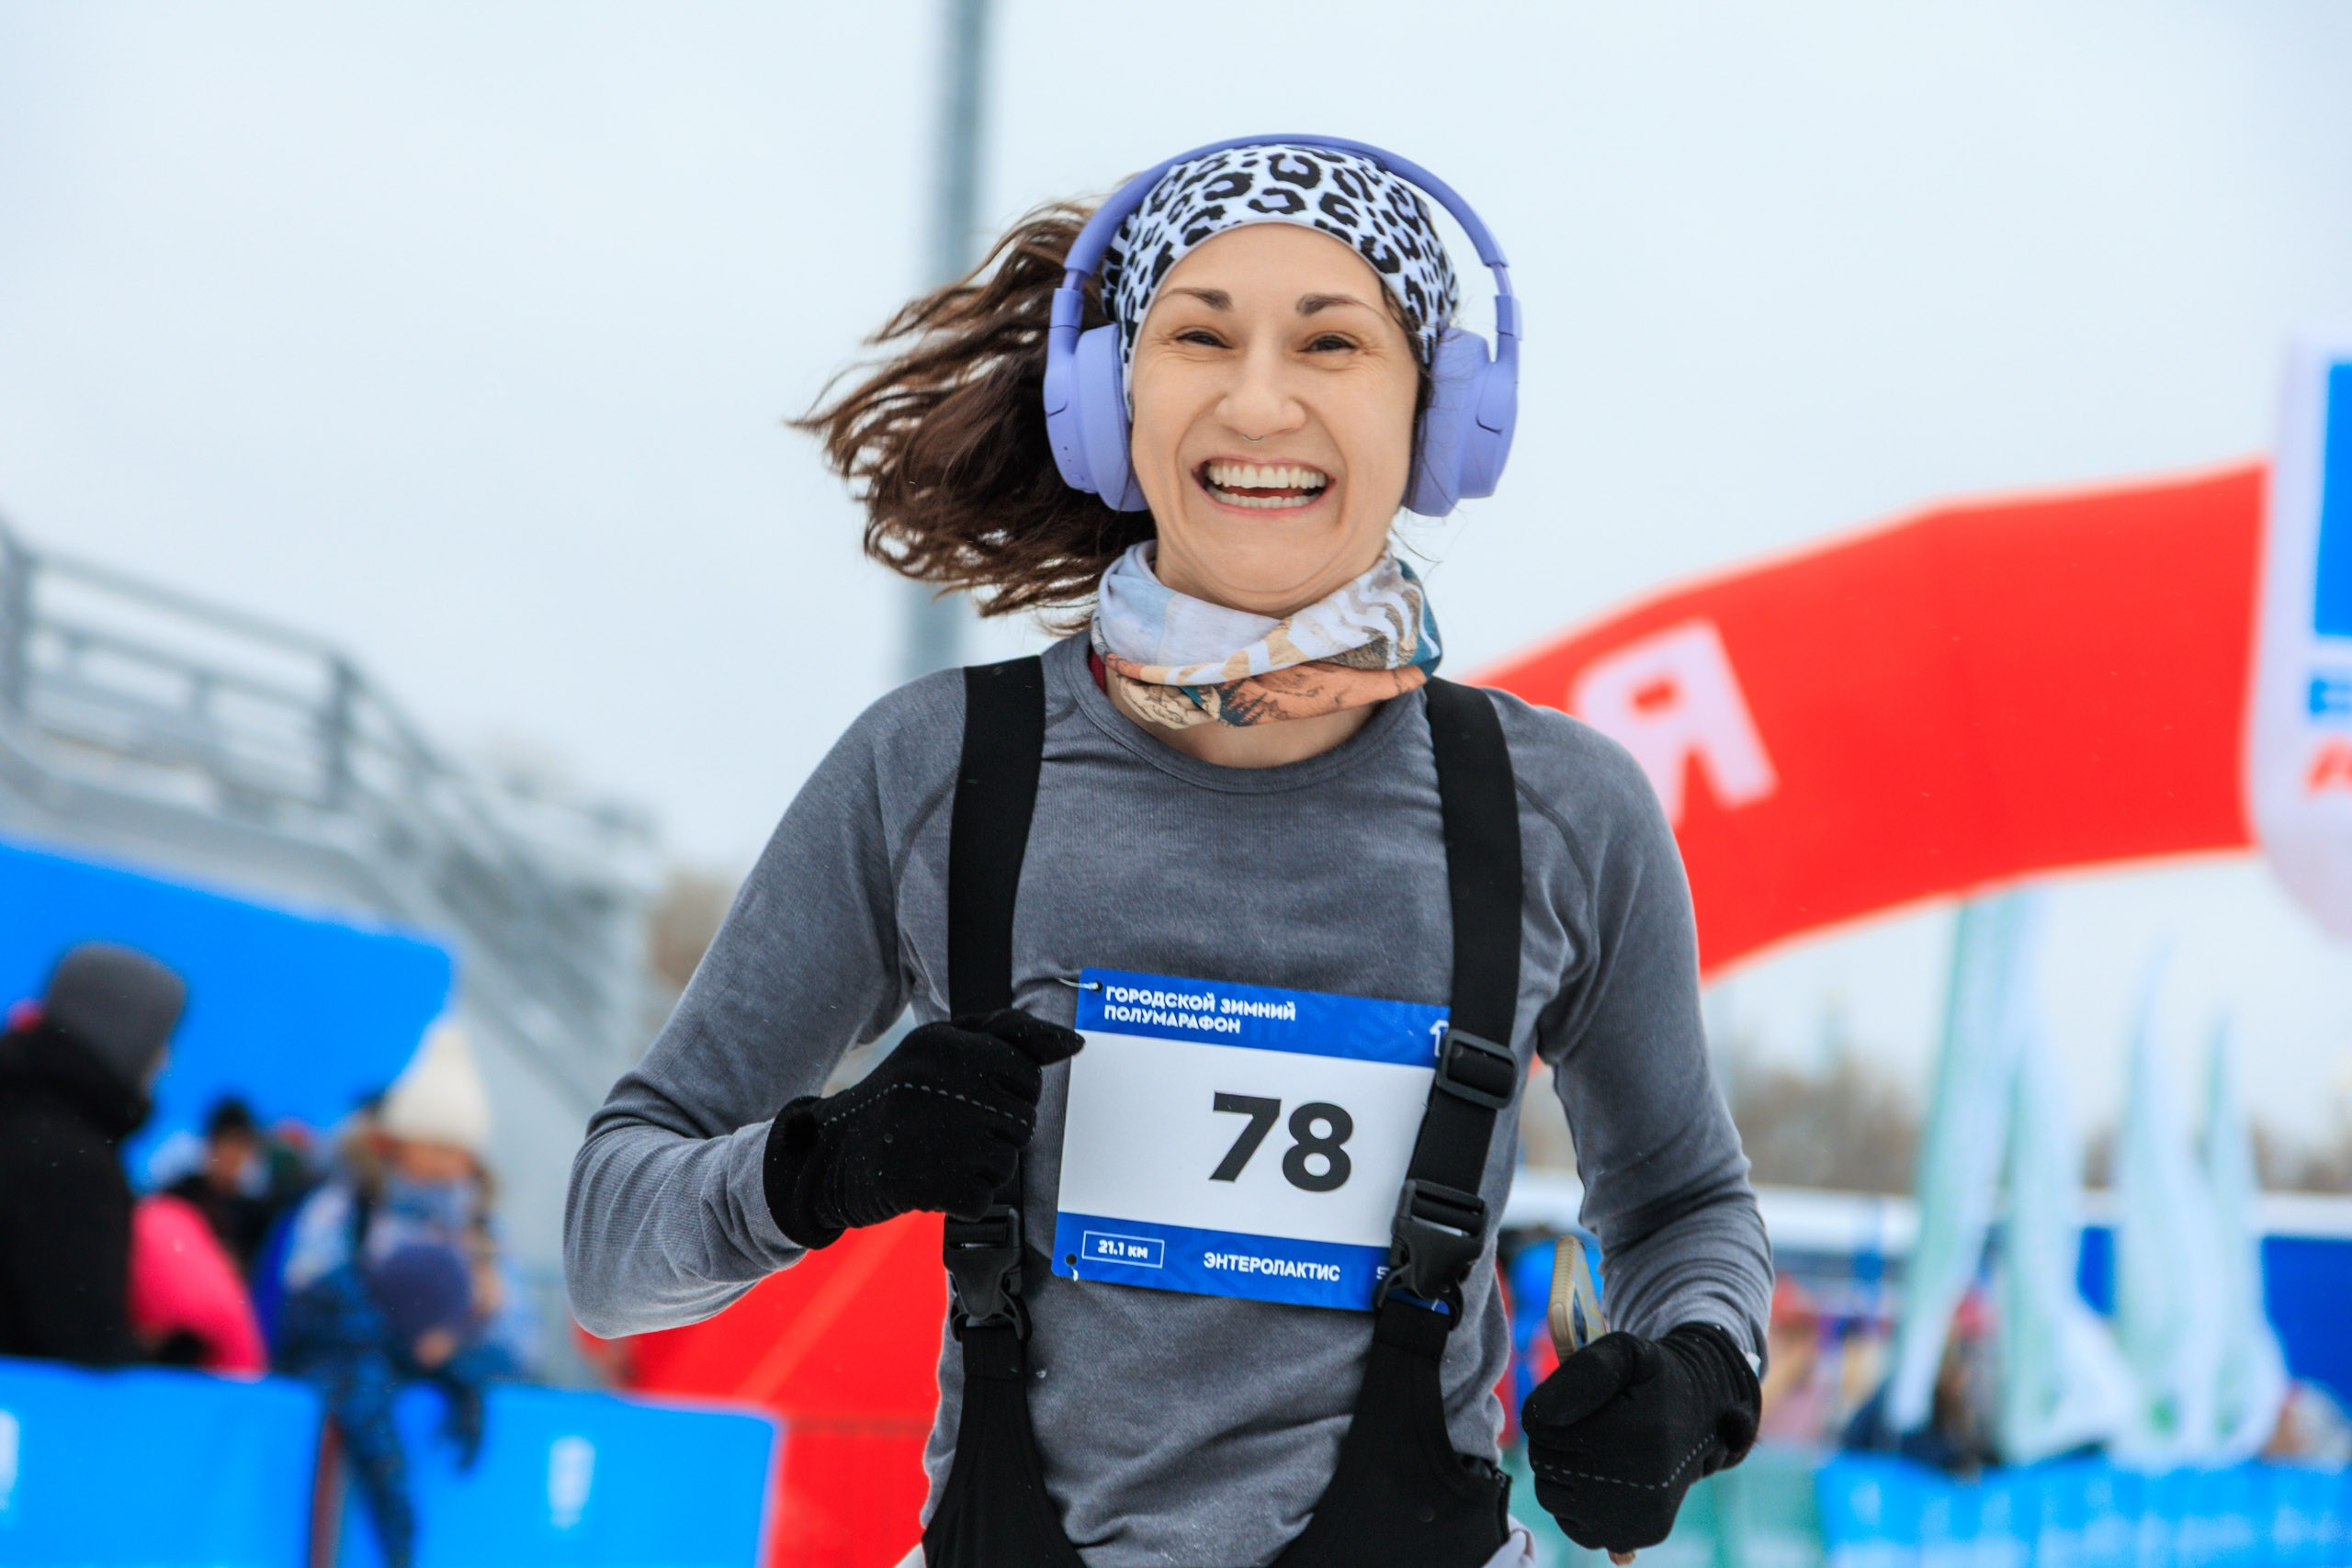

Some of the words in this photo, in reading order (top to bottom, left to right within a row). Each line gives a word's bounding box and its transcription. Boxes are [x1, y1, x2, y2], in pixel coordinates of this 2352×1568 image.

[1105, 985, 1216, 1013] ГОРОДСКОЙ
[1219, 998, 1296, 1021] ЗИМНИЙ
[1103, 1004, 1241, 1034] ПОЛУМАРАФОН
[1208, 1090, 1354, 1192] 78
[1097, 1239, 1125, 1257] 21.1
[1203, 1251, 1341, 1282] ЭНТЕРОЛАКТИС
